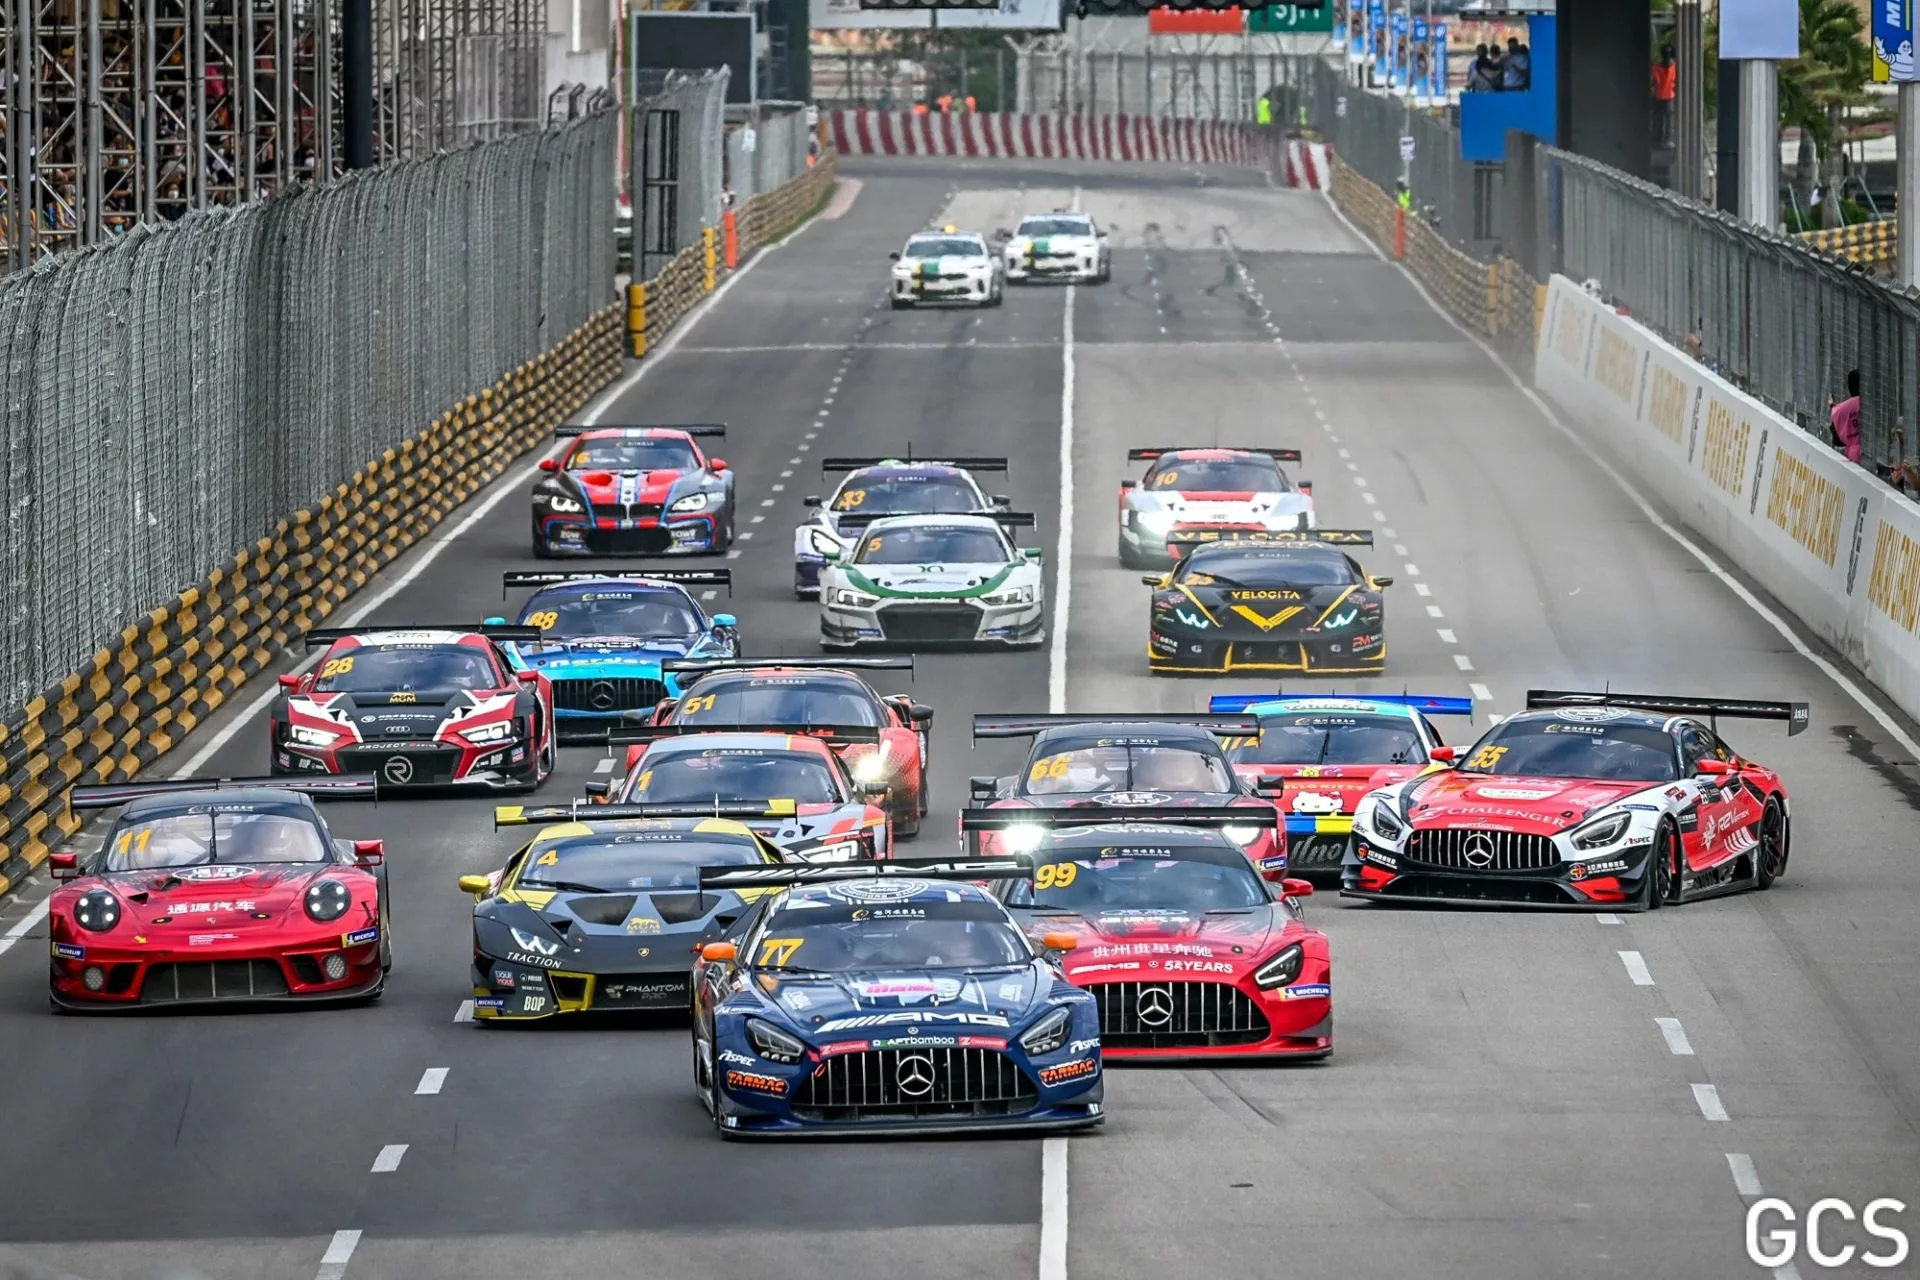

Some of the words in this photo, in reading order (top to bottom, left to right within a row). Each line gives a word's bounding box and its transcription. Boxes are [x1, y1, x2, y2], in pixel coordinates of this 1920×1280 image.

[1155, 471, 1178, 486] 10
[867, 537, 883, 551] 5
[1231, 591, 1301, 600] VELOCITA
[528, 611, 558, 630] 88
[320, 656, 354, 677] 28
[683, 694, 716, 715] 51
[358, 742, 407, 750] PROJECT
[1468, 745, 1509, 768] 55
[1029, 754, 1071, 781] 66
[637, 770, 653, 792] 1
[1447, 806, 1566, 828] CHALLENGER
[116, 827, 153, 856] 11
[537, 849, 560, 866] 4
[1034, 861, 1077, 890] 99
[167, 900, 256, 915] 通源汽车
[506, 951, 562, 969] TRACTION
[758, 938, 804, 967] 77
[625, 983, 684, 993] PHANTOM
[523, 996, 546, 1011] BOP
[727, 1071, 785, 1092] TARMAC
[1039, 1060, 1094, 1082] TARMAC
